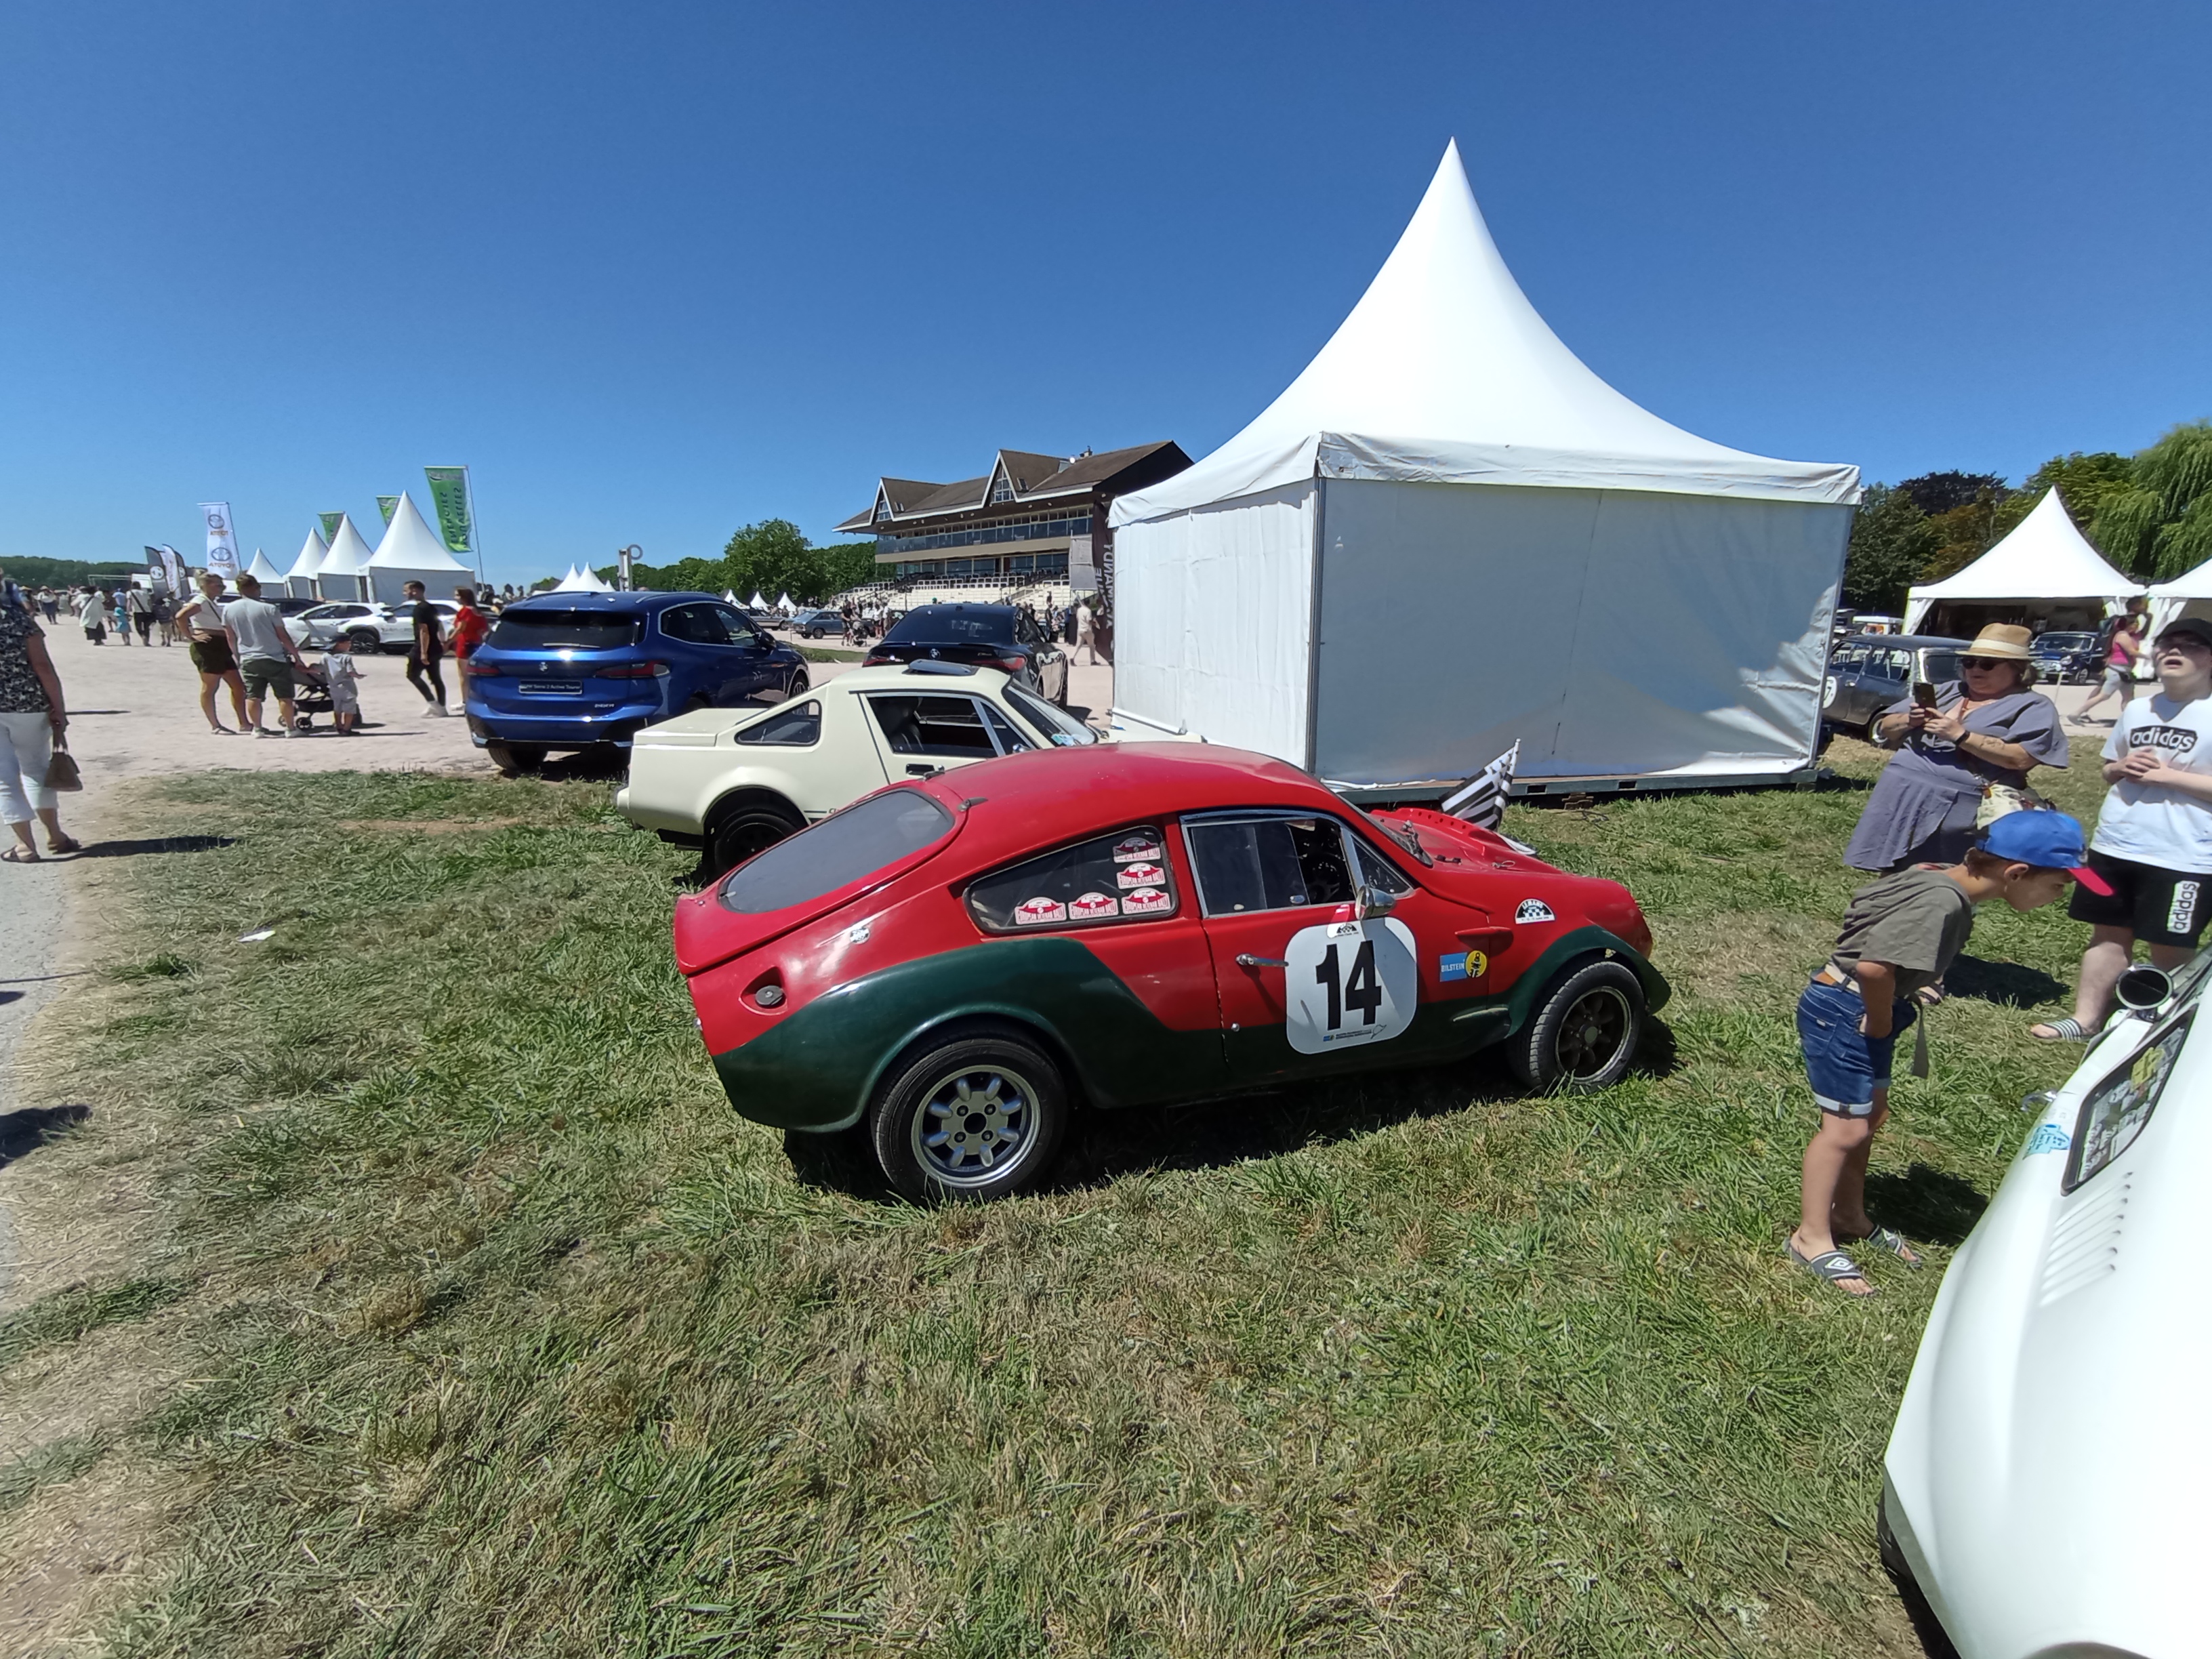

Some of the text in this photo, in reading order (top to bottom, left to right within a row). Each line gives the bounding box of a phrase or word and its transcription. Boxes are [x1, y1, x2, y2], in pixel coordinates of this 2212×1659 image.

[2131, 727, 2194, 750] adidas
[2173, 883, 2196, 930] adidas
[1441, 962, 1465, 972] BILSTEIN
[1315, 940, 1381, 1031] 14
